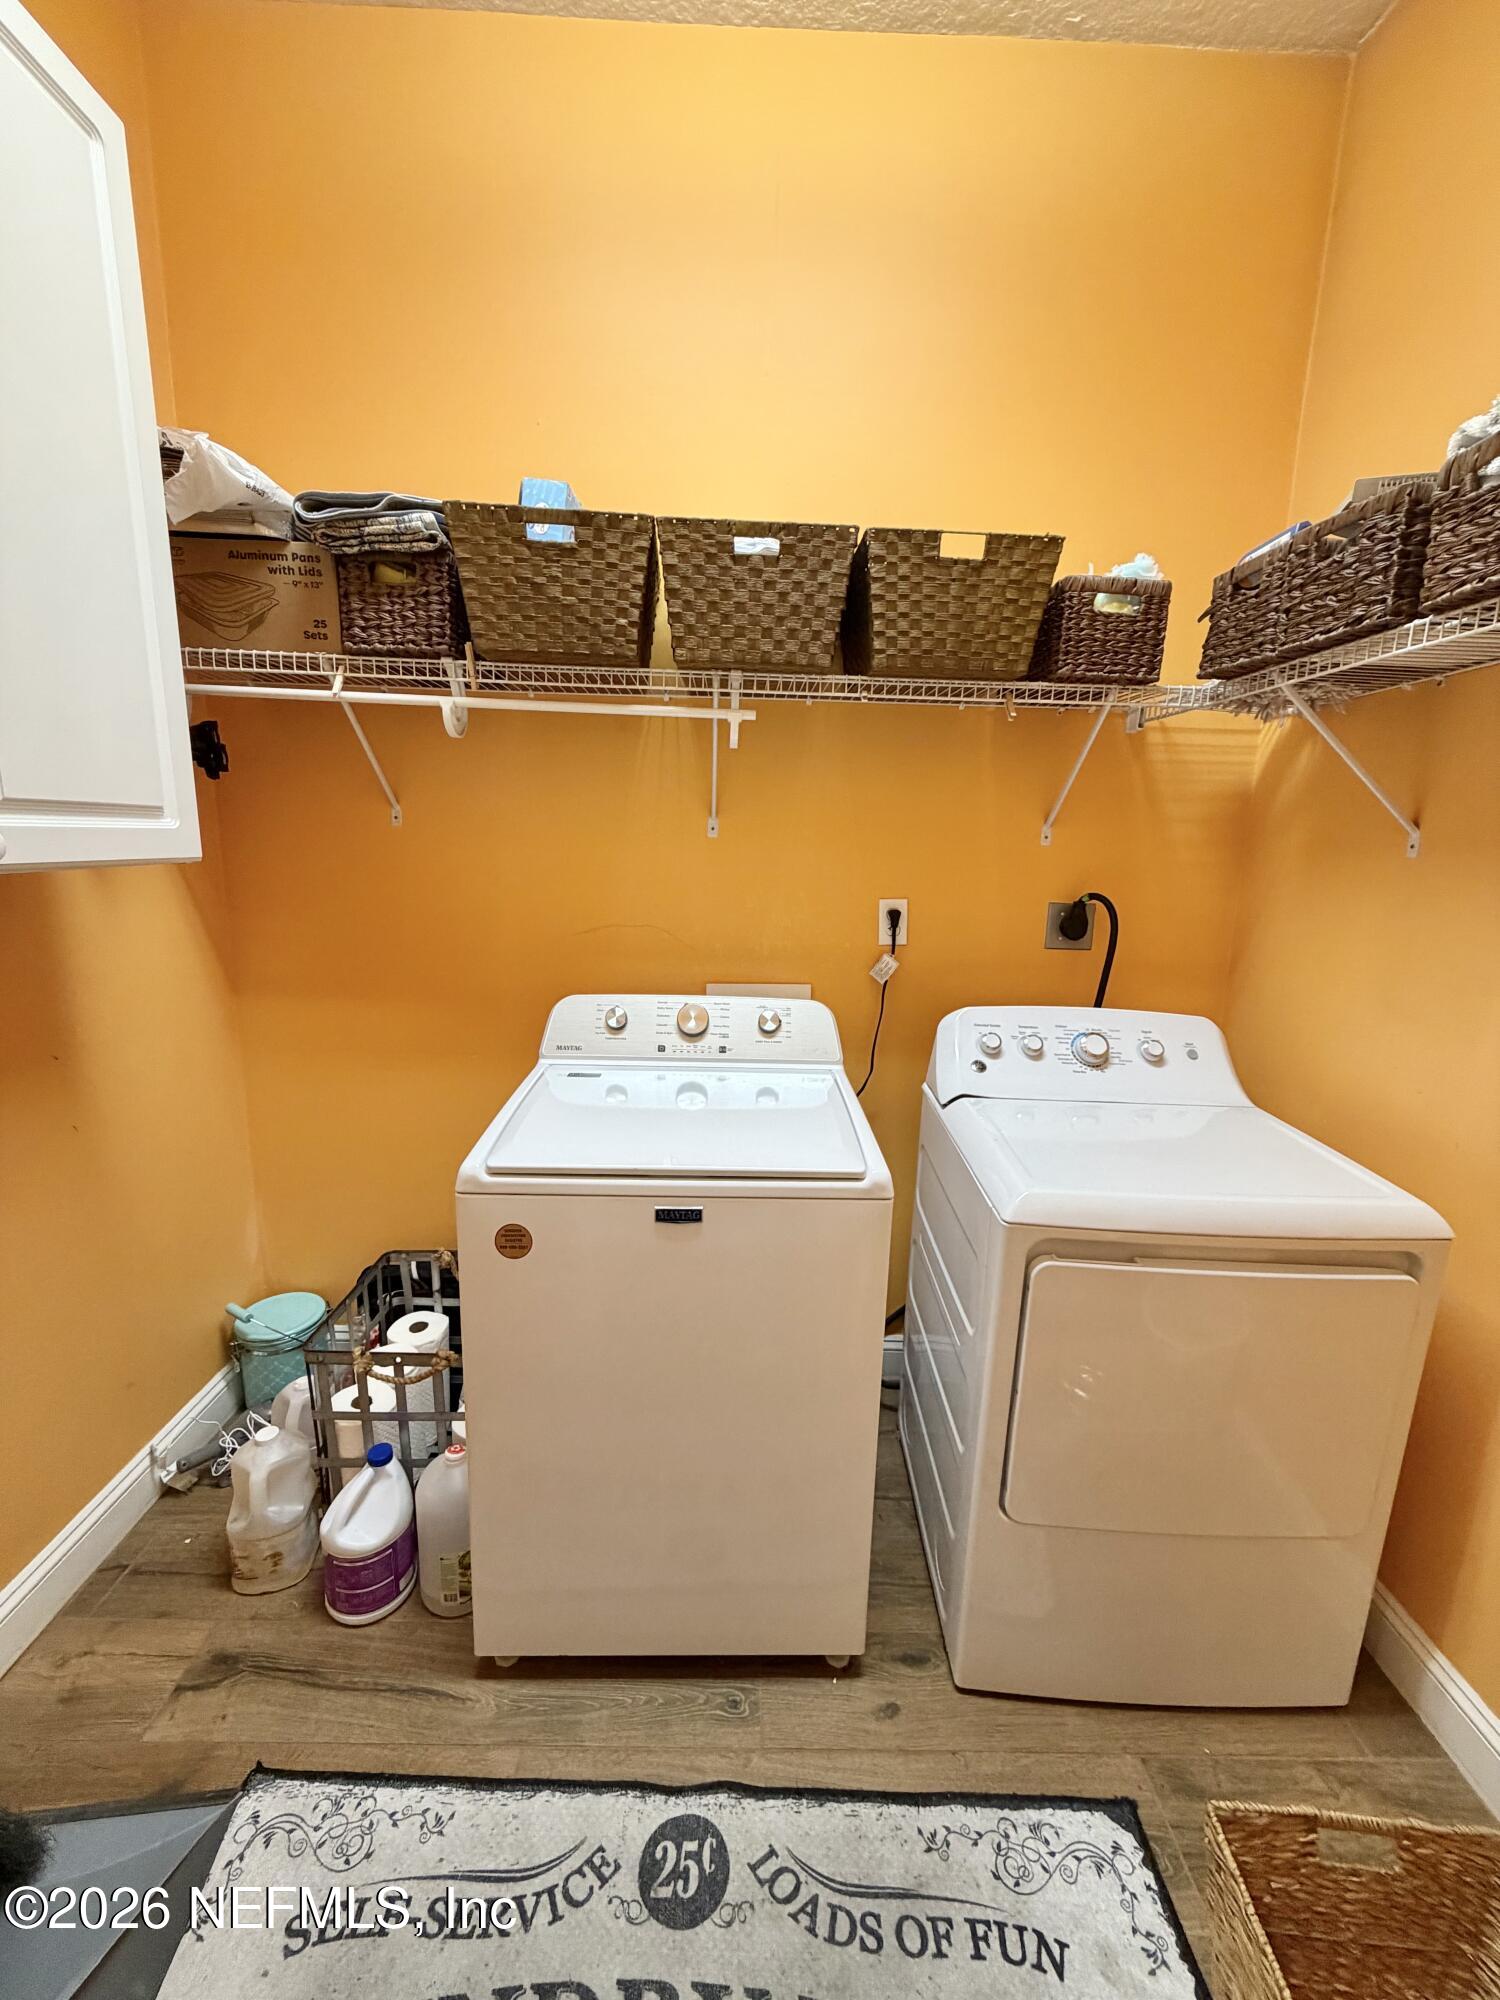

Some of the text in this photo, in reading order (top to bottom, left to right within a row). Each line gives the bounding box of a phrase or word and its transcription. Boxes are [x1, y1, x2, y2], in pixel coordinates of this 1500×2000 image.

[227, 550, 321, 563] Aluminum Pans
[267, 565, 323, 577] with Lids
[313, 619, 328, 629] 25
[303, 630, 328, 641] Sets
[657, 1210, 701, 1220] MAYTAG
[747, 1843, 1070, 1983] LOADS OF FUN
